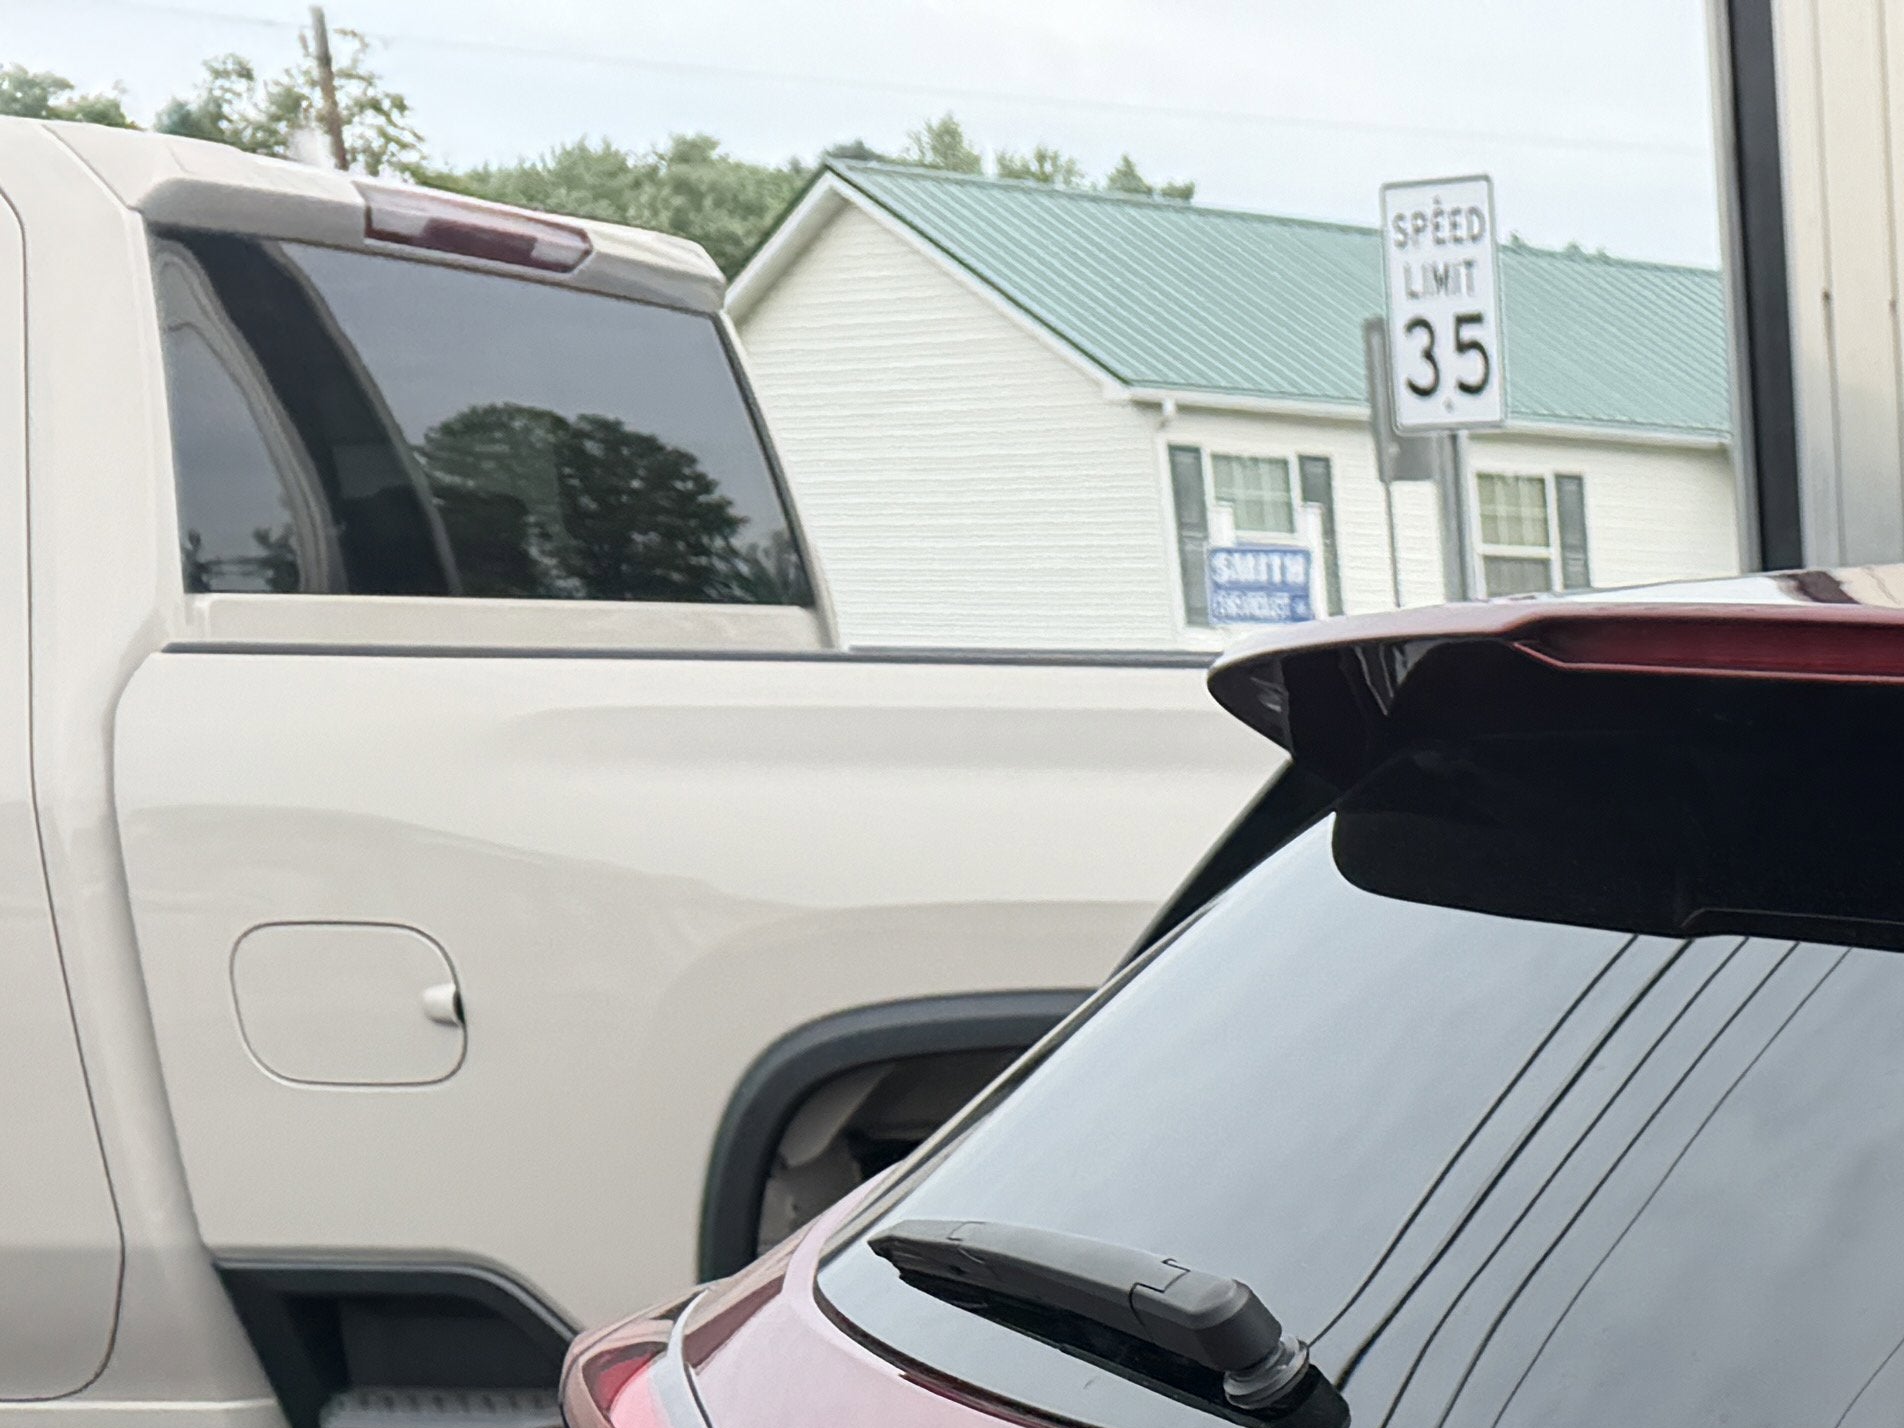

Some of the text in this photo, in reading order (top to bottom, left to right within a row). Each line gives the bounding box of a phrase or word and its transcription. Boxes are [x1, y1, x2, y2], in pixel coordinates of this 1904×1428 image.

[1391, 205, 1487, 250] SPEED
[1403, 258, 1477, 300] LIMIT
[1403, 311, 1490, 398] 35
[1210, 551, 1306, 585] SMITH
